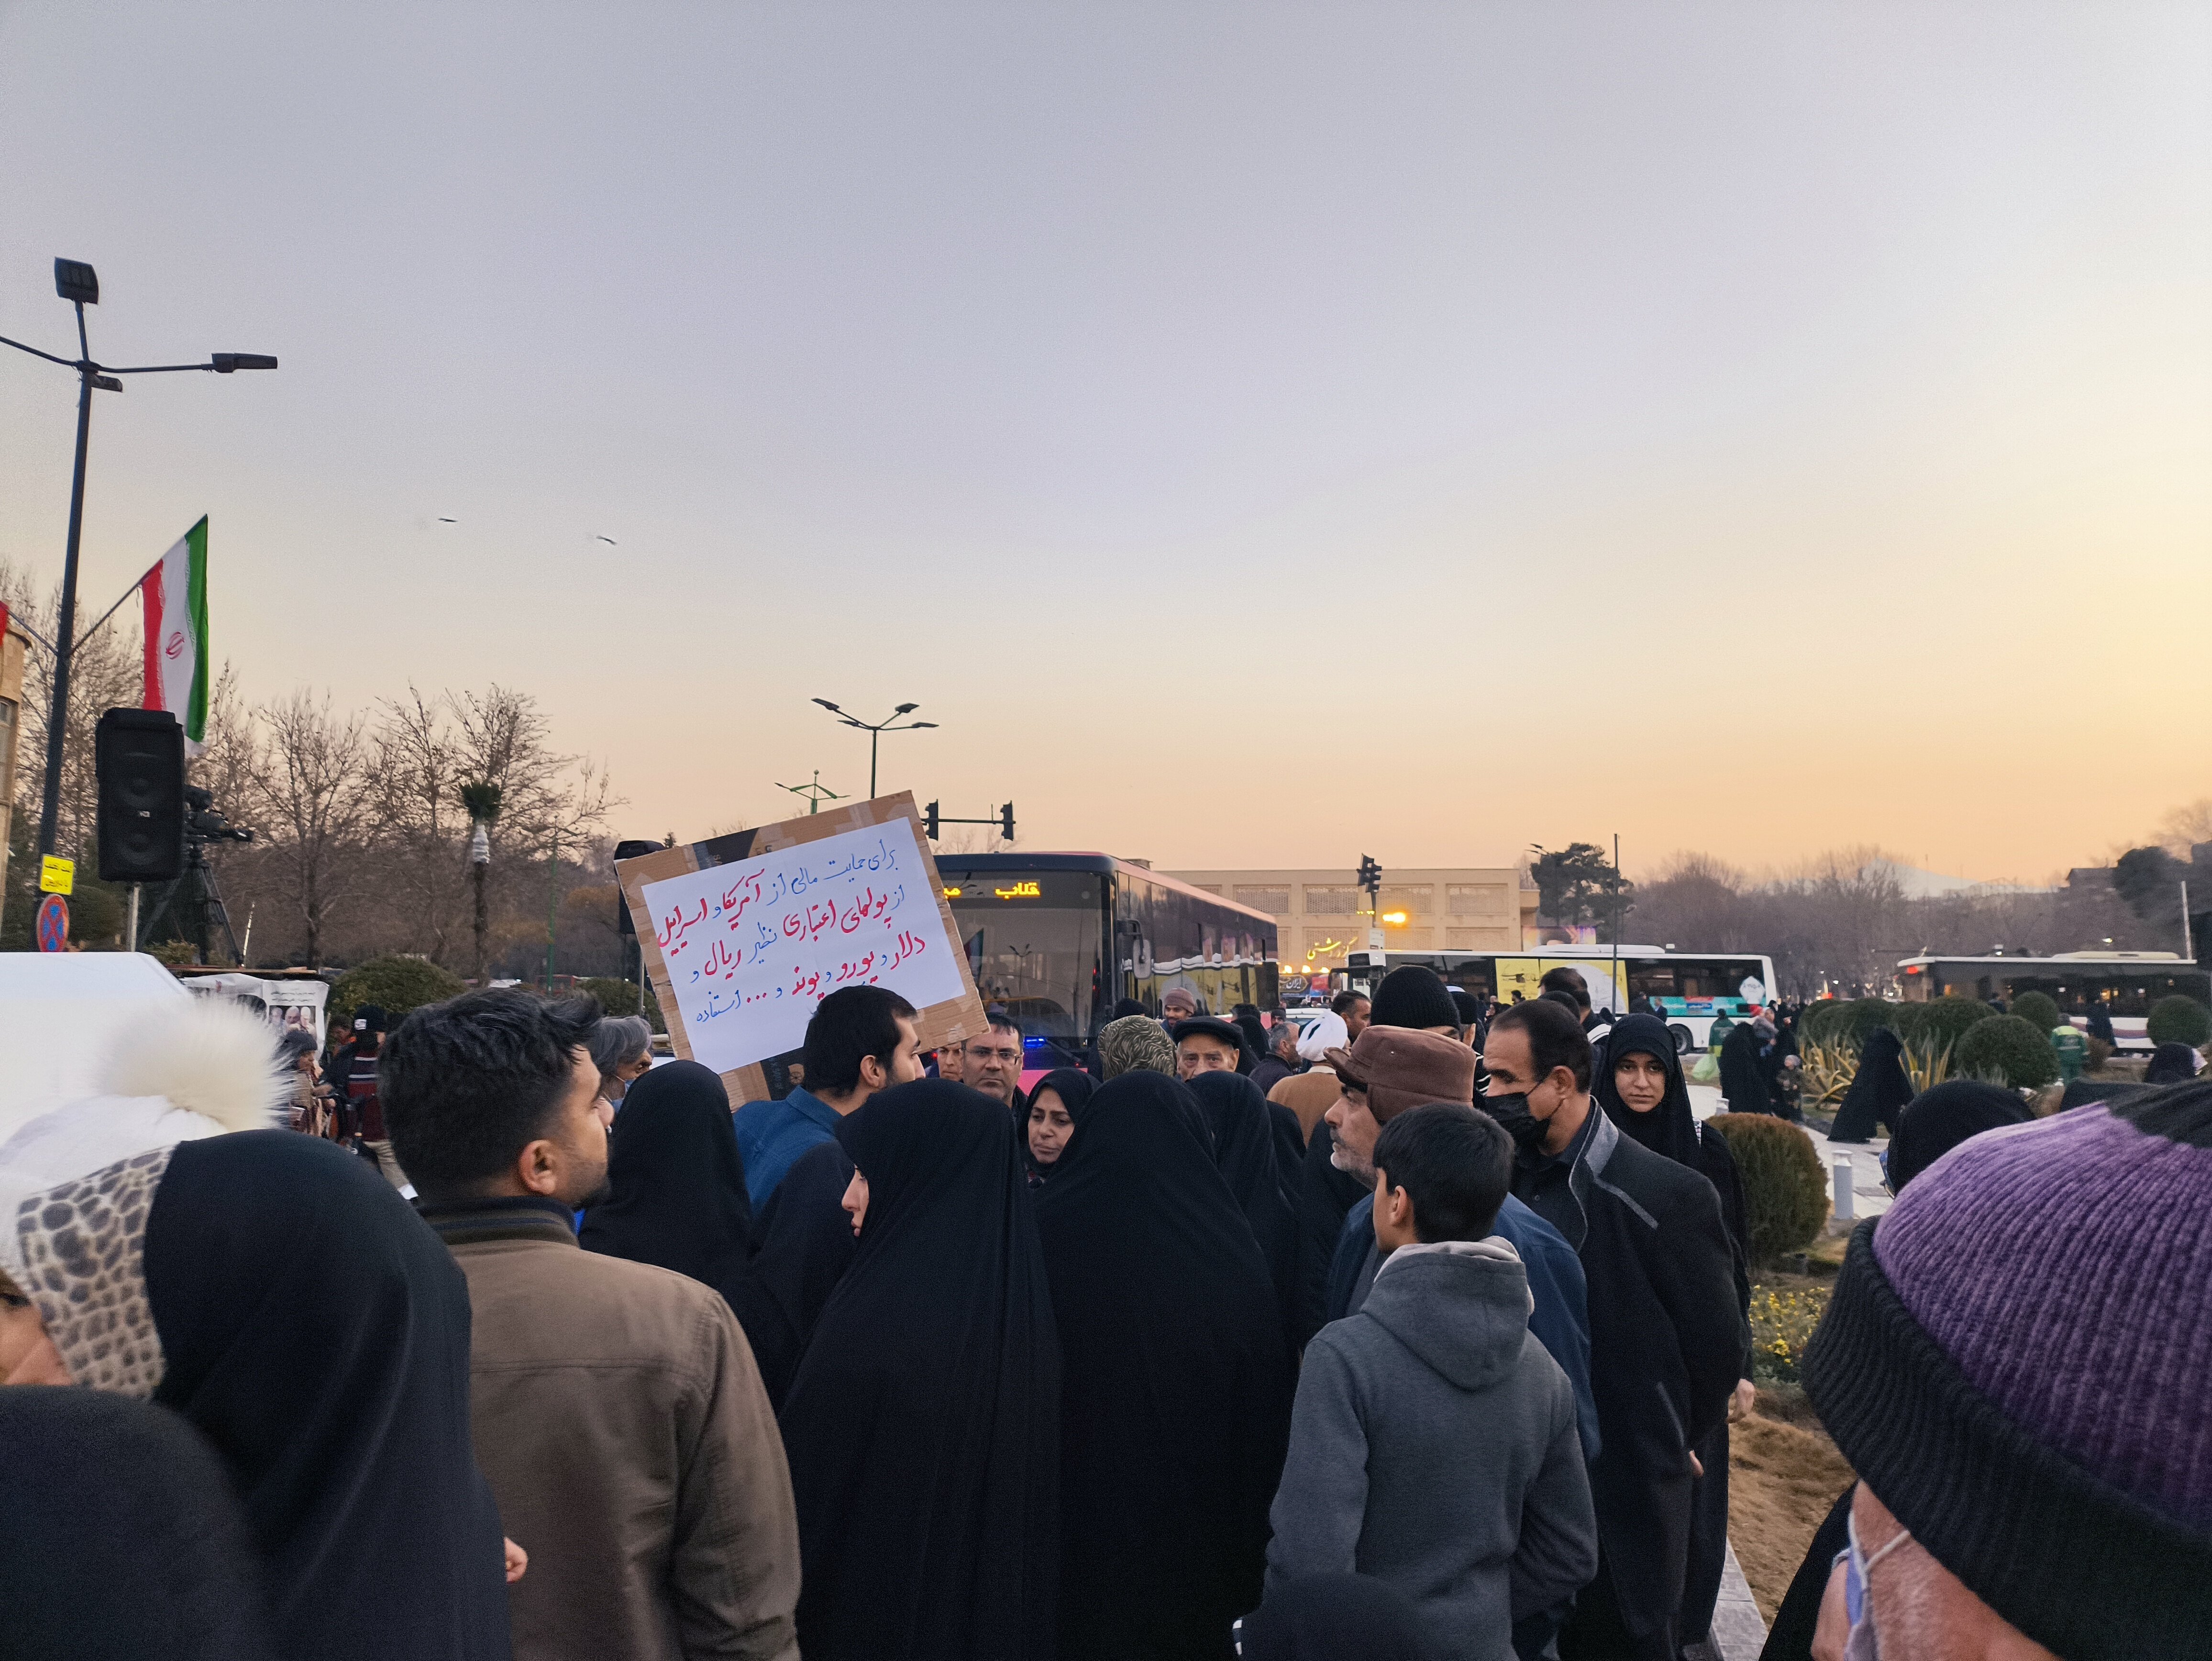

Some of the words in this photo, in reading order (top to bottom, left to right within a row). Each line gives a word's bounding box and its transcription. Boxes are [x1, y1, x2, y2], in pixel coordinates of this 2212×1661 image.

[823, 853, 866, 883] حمایت
[868, 839, 898, 871] برای
[766, 873, 786, 906] از
[791, 867, 818, 894] مالی
[712, 906, 721, 919] و
[723, 868, 765, 930] آمریکا
[841, 887, 891, 933] پولهای
[890, 884, 904, 910] از
[783, 899, 836, 941] اعتباری
[747, 921, 777, 964] نظیر
[890, 930, 925, 970] دلار
[705, 939, 741, 980] ریال
[836, 951, 878, 984] یورو
[880, 954, 887, 966] و
[690, 970, 699, 983] و
[775, 987, 782, 998] و
[825, 971, 831, 983] و
[1286, 977, 1302, 989] ایران
[697, 989, 741, 1022] استفاده
